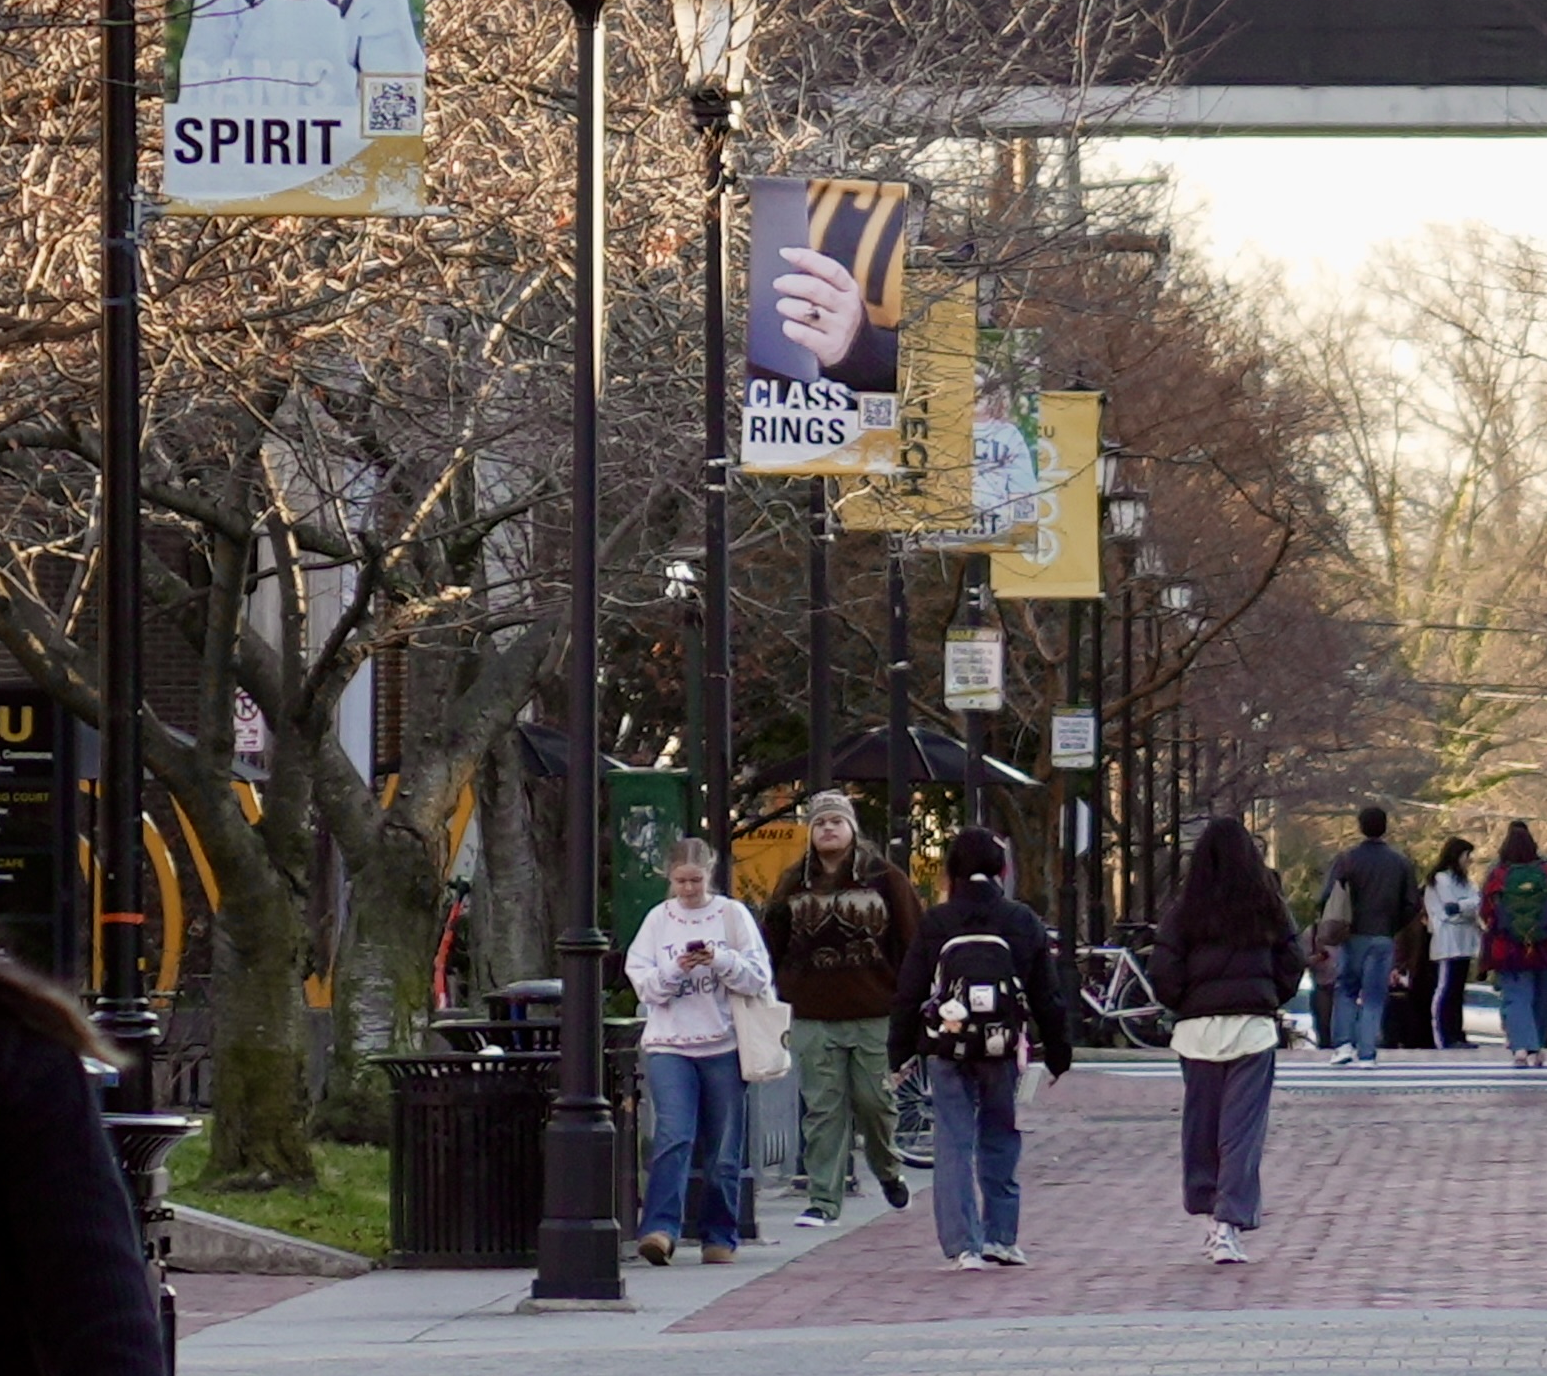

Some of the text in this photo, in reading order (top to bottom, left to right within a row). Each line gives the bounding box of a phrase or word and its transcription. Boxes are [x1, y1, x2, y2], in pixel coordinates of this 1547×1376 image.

[173, 116, 343, 165] SPIRIT
[749, 378, 849, 411] CLASS
[749, 415, 846, 445] RINGS
